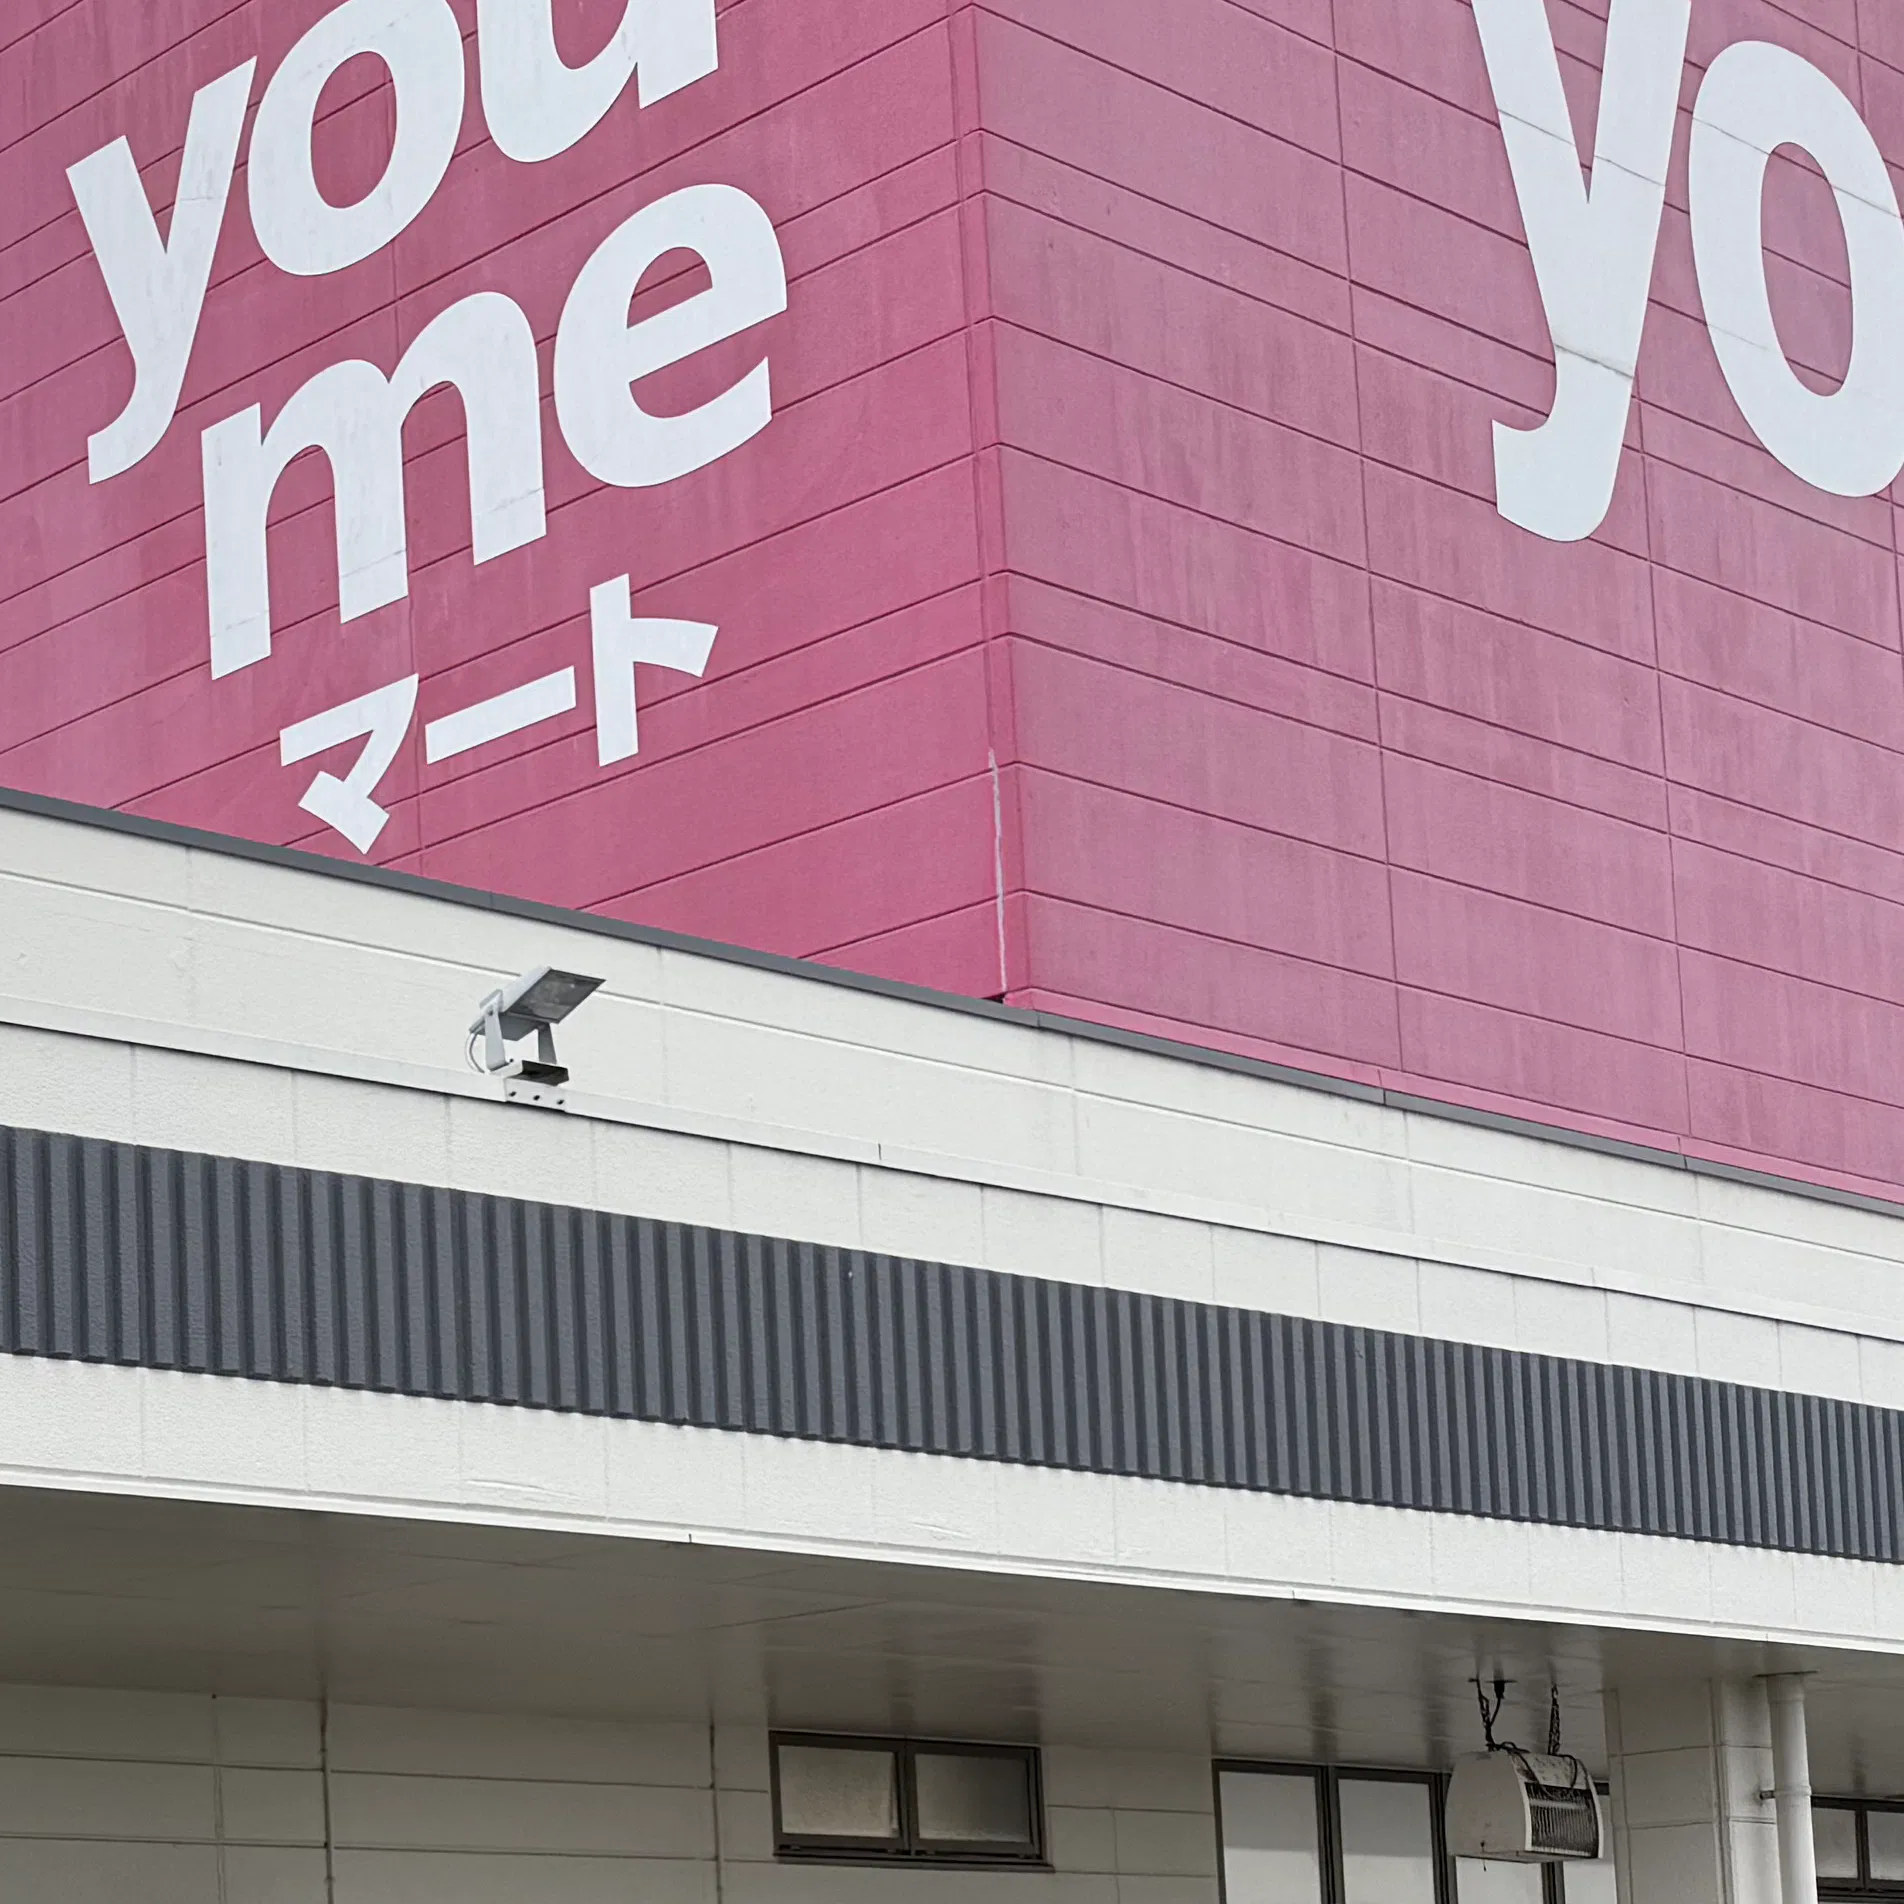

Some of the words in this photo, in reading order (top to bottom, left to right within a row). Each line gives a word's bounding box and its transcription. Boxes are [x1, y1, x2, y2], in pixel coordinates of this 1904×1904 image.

[66, 0, 718, 484] you
[201, 183, 787, 680] me
[280, 573, 718, 853] マート
